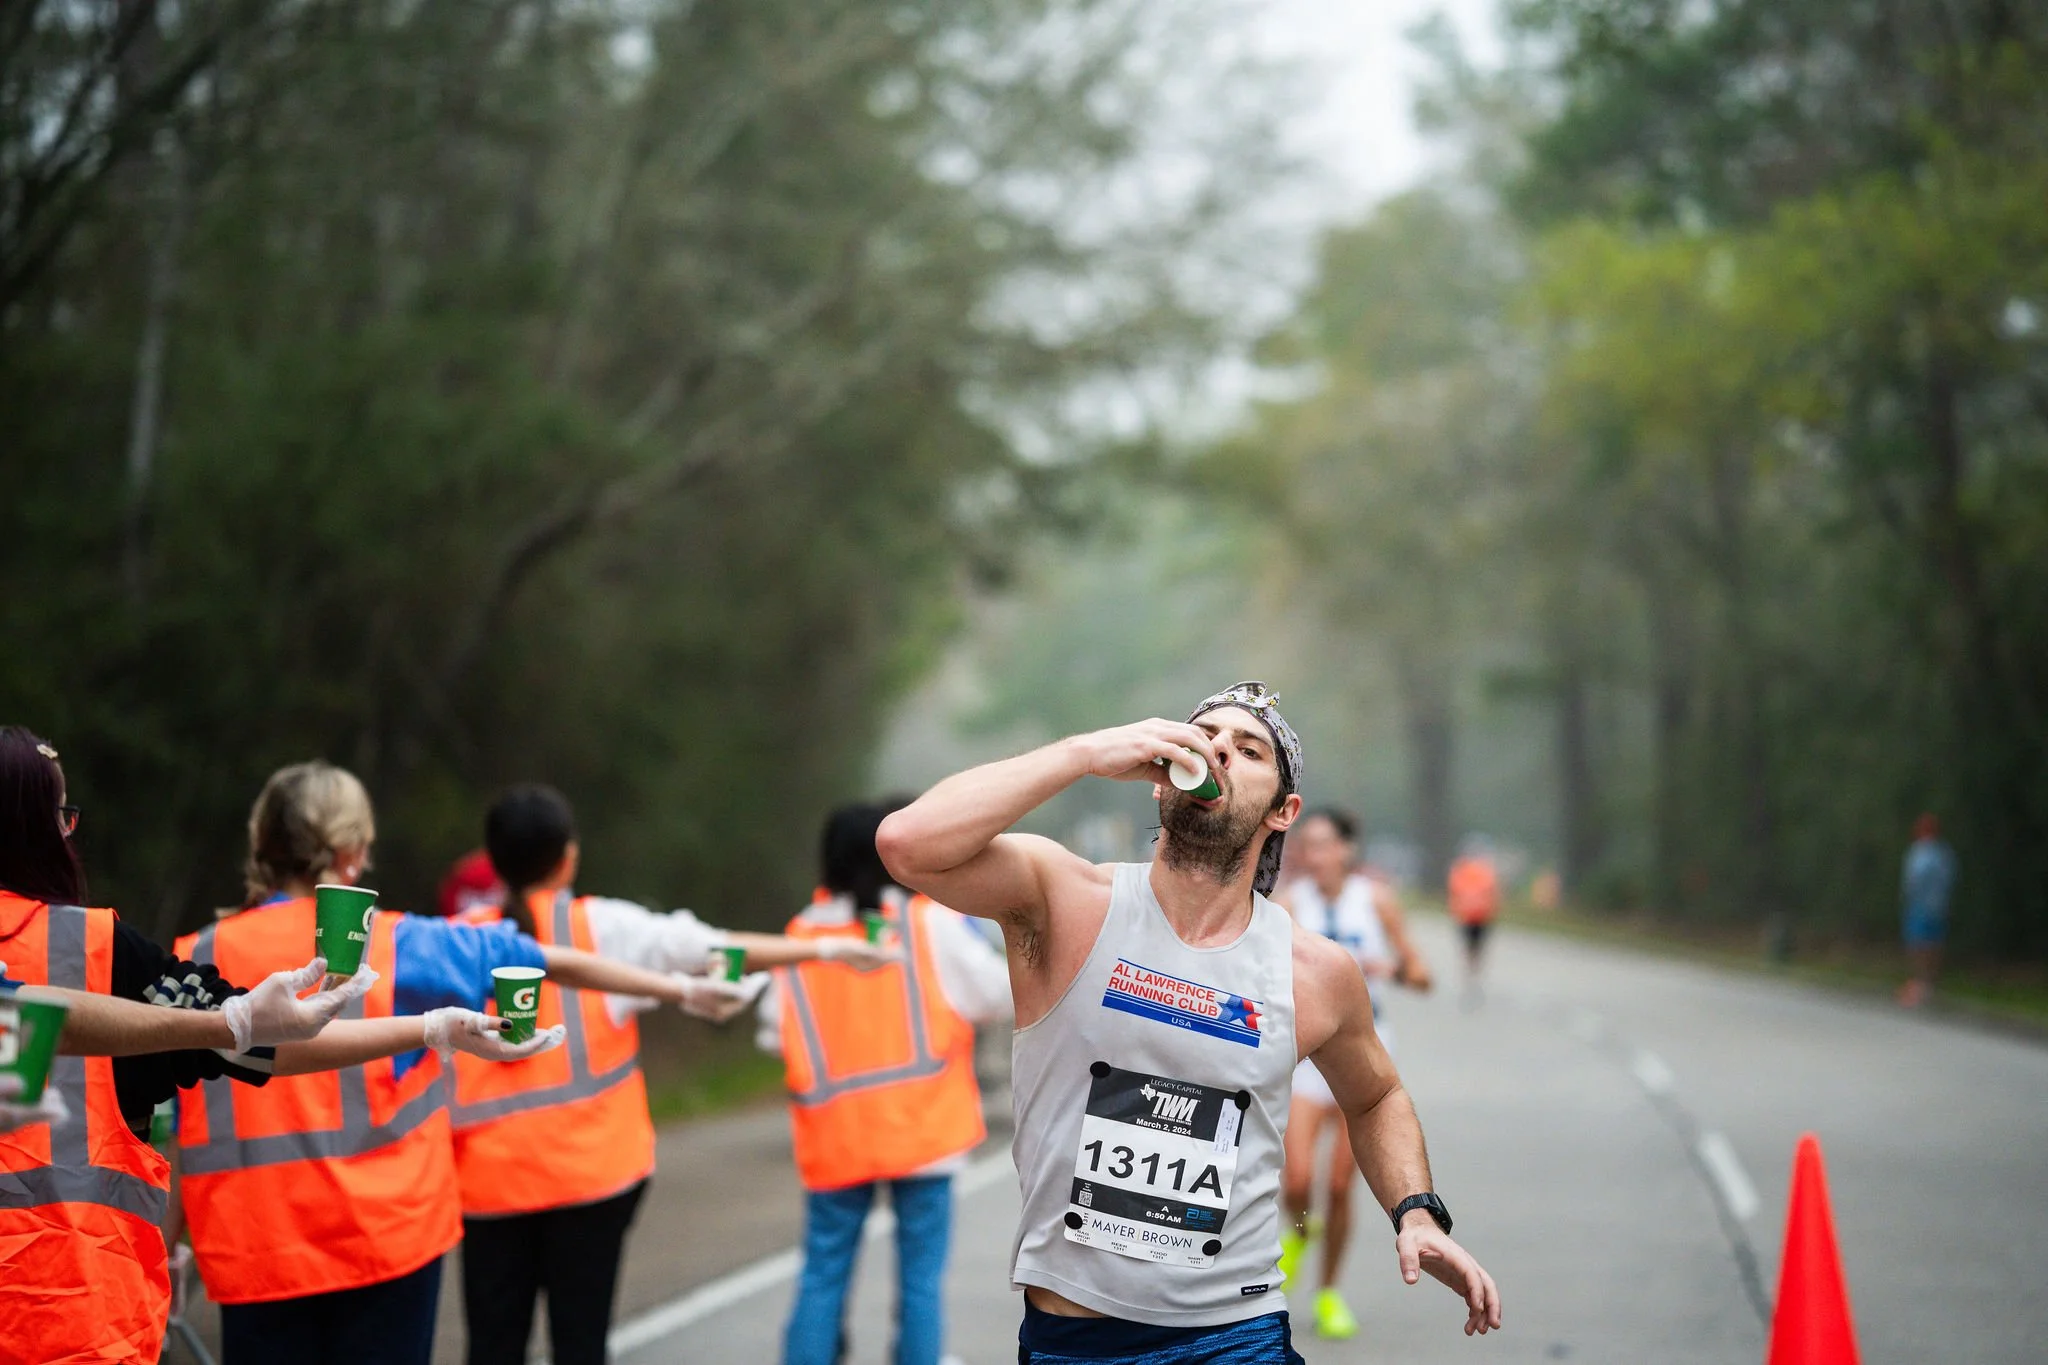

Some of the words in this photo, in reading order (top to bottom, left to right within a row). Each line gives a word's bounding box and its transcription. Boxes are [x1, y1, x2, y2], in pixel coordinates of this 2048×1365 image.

[1113, 963, 1131, 978] AL
[1135, 970, 1216, 1002] LAWRENCE
[513, 987, 536, 1010] G
[1108, 976, 1175, 1005] RUNNING
[1178, 998, 1218, 1017] CLUB
[1171, 1017, 1192, 1028] USA
[1150, 1078, 1176, 1089] LEGACY
[1176, 1084, 1203, 1095] CAPITAL
[1152, 1091, 1198, 1122] TWM
[1136, 1118, 1161, 1129] March
[1162, 1124, 1171, 1132] 2,
[1172, 1126, 1192, 1136] 2024
[1084, 1139, 1224, 1199] 1311A
[1145, 1210, 1165, 1220] 6:50
[1166, 1215, 1182, 1224] AM
[1161, 1205, 1170, 1213] A
[1091, 1218, 1136, 1239] MAYER
[1141, 1230, 1193, 1248] BROWN
